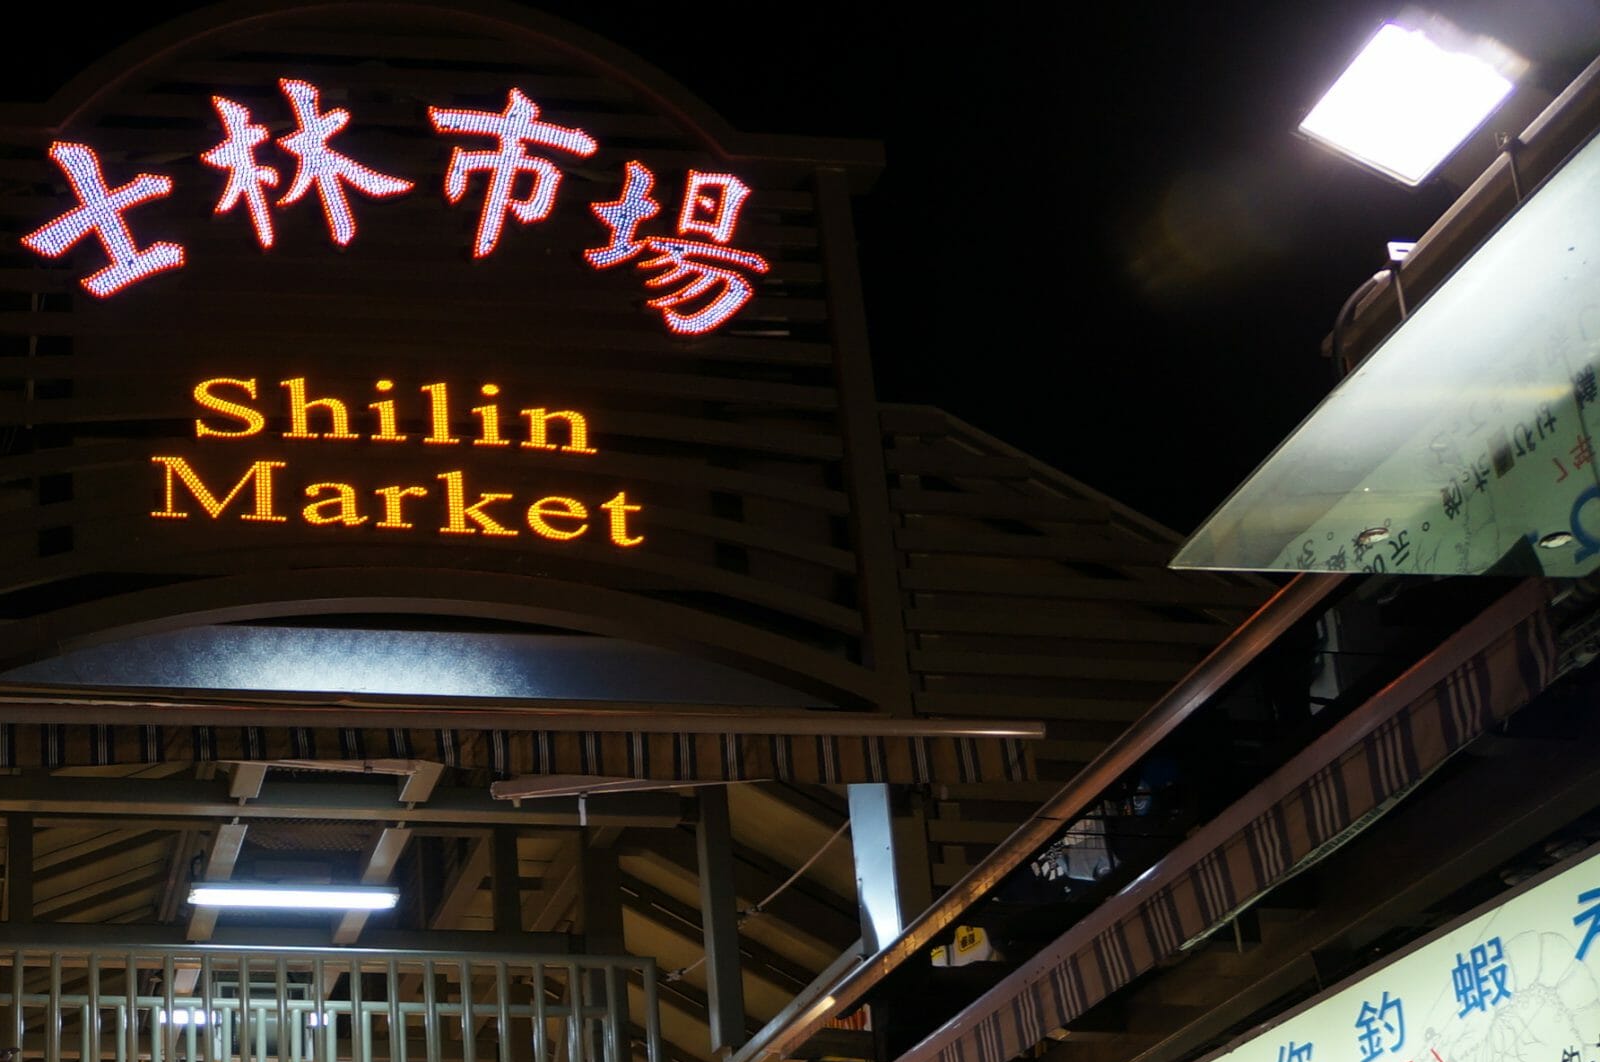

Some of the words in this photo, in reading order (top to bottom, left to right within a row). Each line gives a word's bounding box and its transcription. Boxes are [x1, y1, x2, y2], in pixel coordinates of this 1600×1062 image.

[21, 77, 769, 335] 士林市場
[193, 376, 598, 454] Shilin
[150, 454, 646, 547] Market
